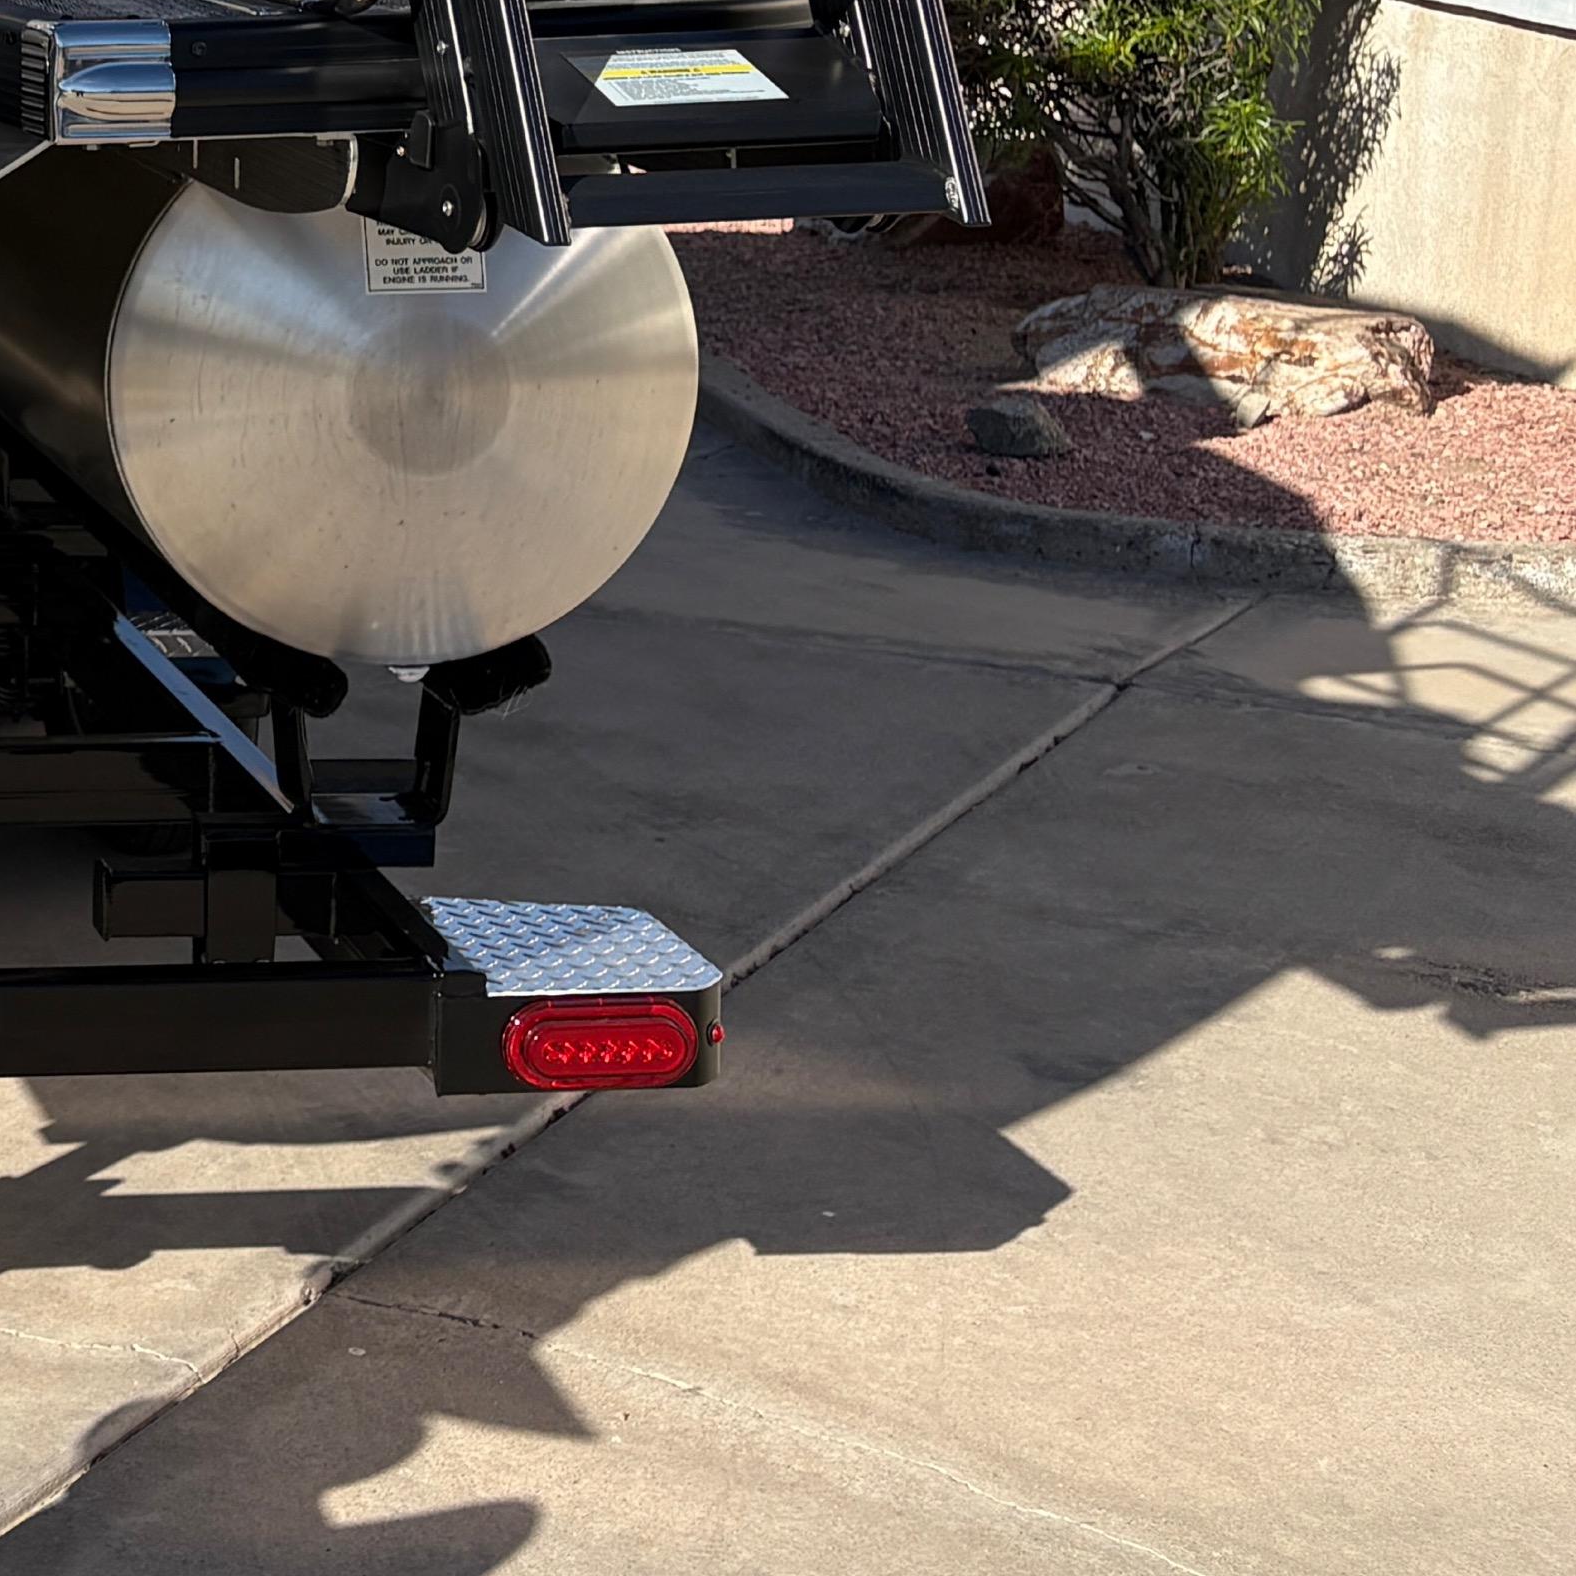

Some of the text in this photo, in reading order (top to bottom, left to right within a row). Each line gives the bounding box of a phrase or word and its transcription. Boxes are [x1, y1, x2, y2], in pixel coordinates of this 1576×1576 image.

[374, 258, 388, 266] DO
[412, 257, 458, 265] APPROACH
[461, 256, 473, 264] OR
[393, 265, 459, 275] USE LADDER IF
[383, 276, 415, 284] ENGINE
[418, 275, 427, 283] IS
